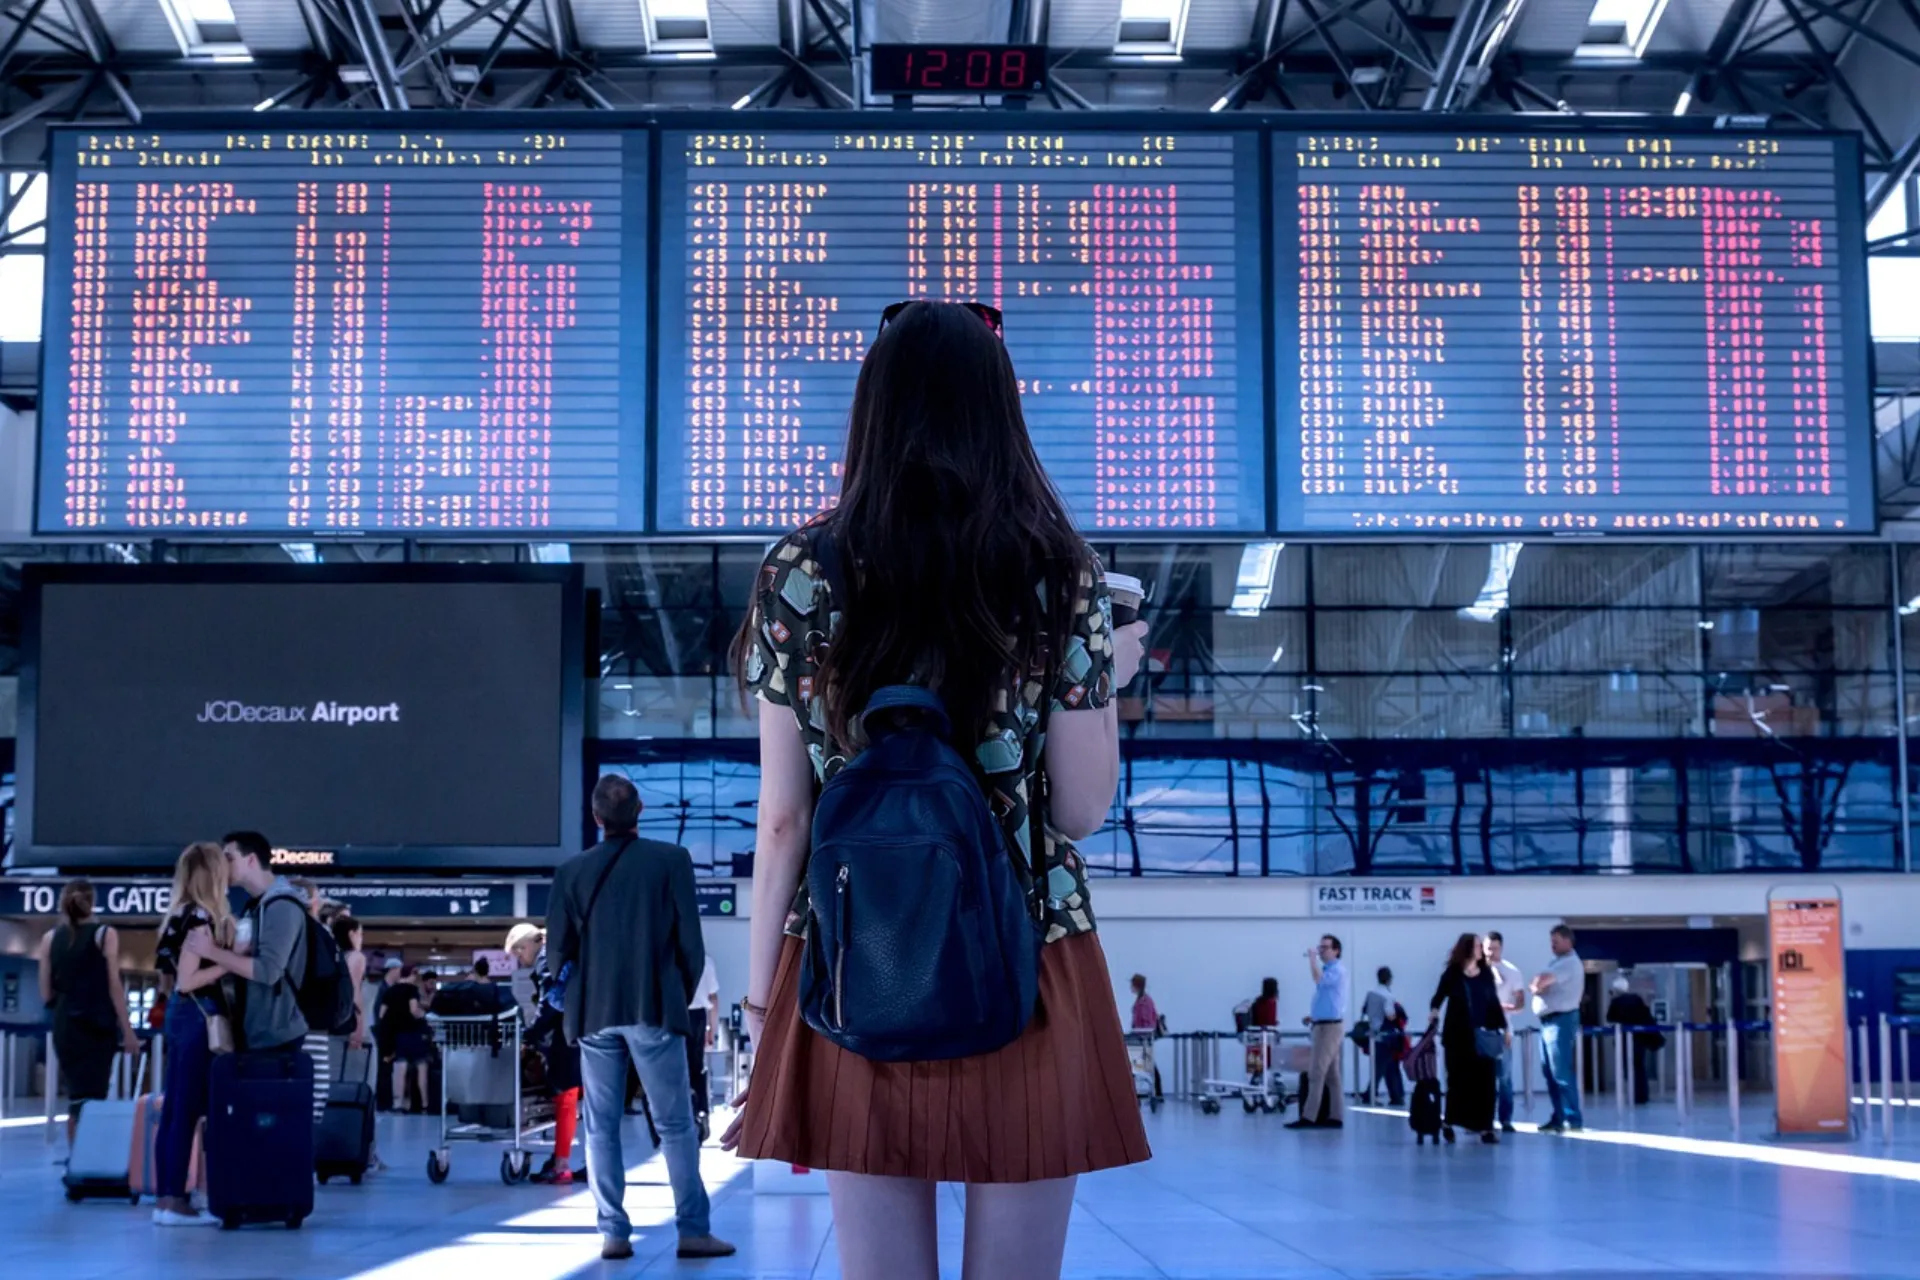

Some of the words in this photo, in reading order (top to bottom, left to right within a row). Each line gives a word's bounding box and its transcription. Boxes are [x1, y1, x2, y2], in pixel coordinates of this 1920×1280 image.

[905, 50, 1025, 87] 12:08
[197, 700, 306, 722] JCDecaux
[311, 701, 399, 726] Airport
[19, 886, 55, 913] TO
[349, 887, 387, 897] PASSPORT
[1319, 886, 1356, 900] FAST
[1362, 886, 1412, 900] TRACK
